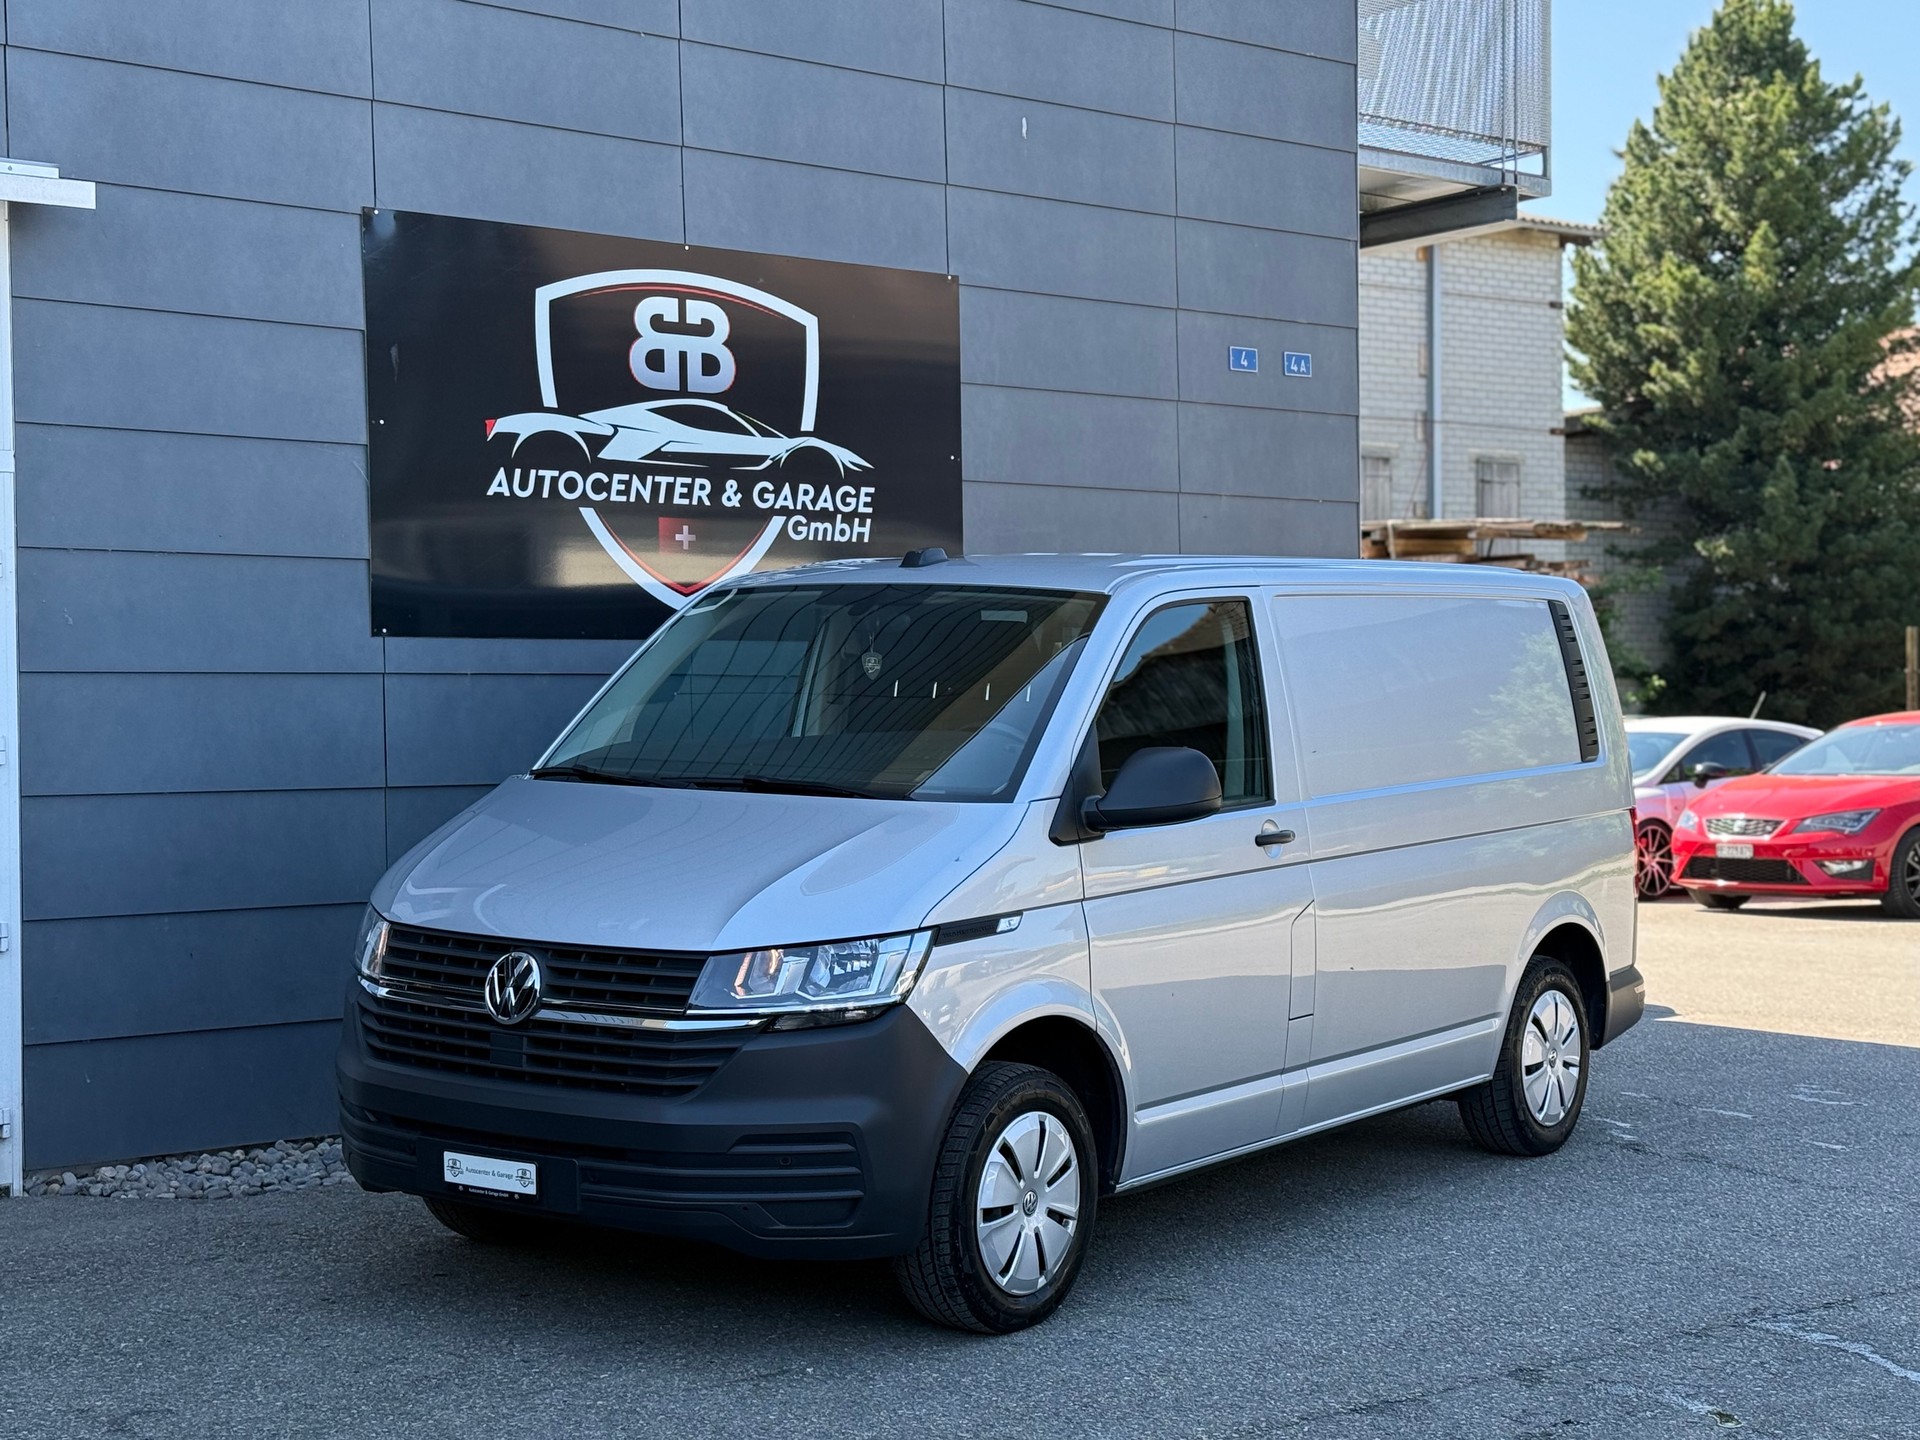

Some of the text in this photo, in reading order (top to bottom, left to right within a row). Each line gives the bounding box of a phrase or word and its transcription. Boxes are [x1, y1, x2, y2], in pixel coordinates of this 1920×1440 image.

[1240, 351, 1248, 367] 4
[1290, 356, 1307, 373] 4A
[486, 467, 875, 513] AUTOCENTER & GARAGE
[787, 514, 872, 543] GmbH
